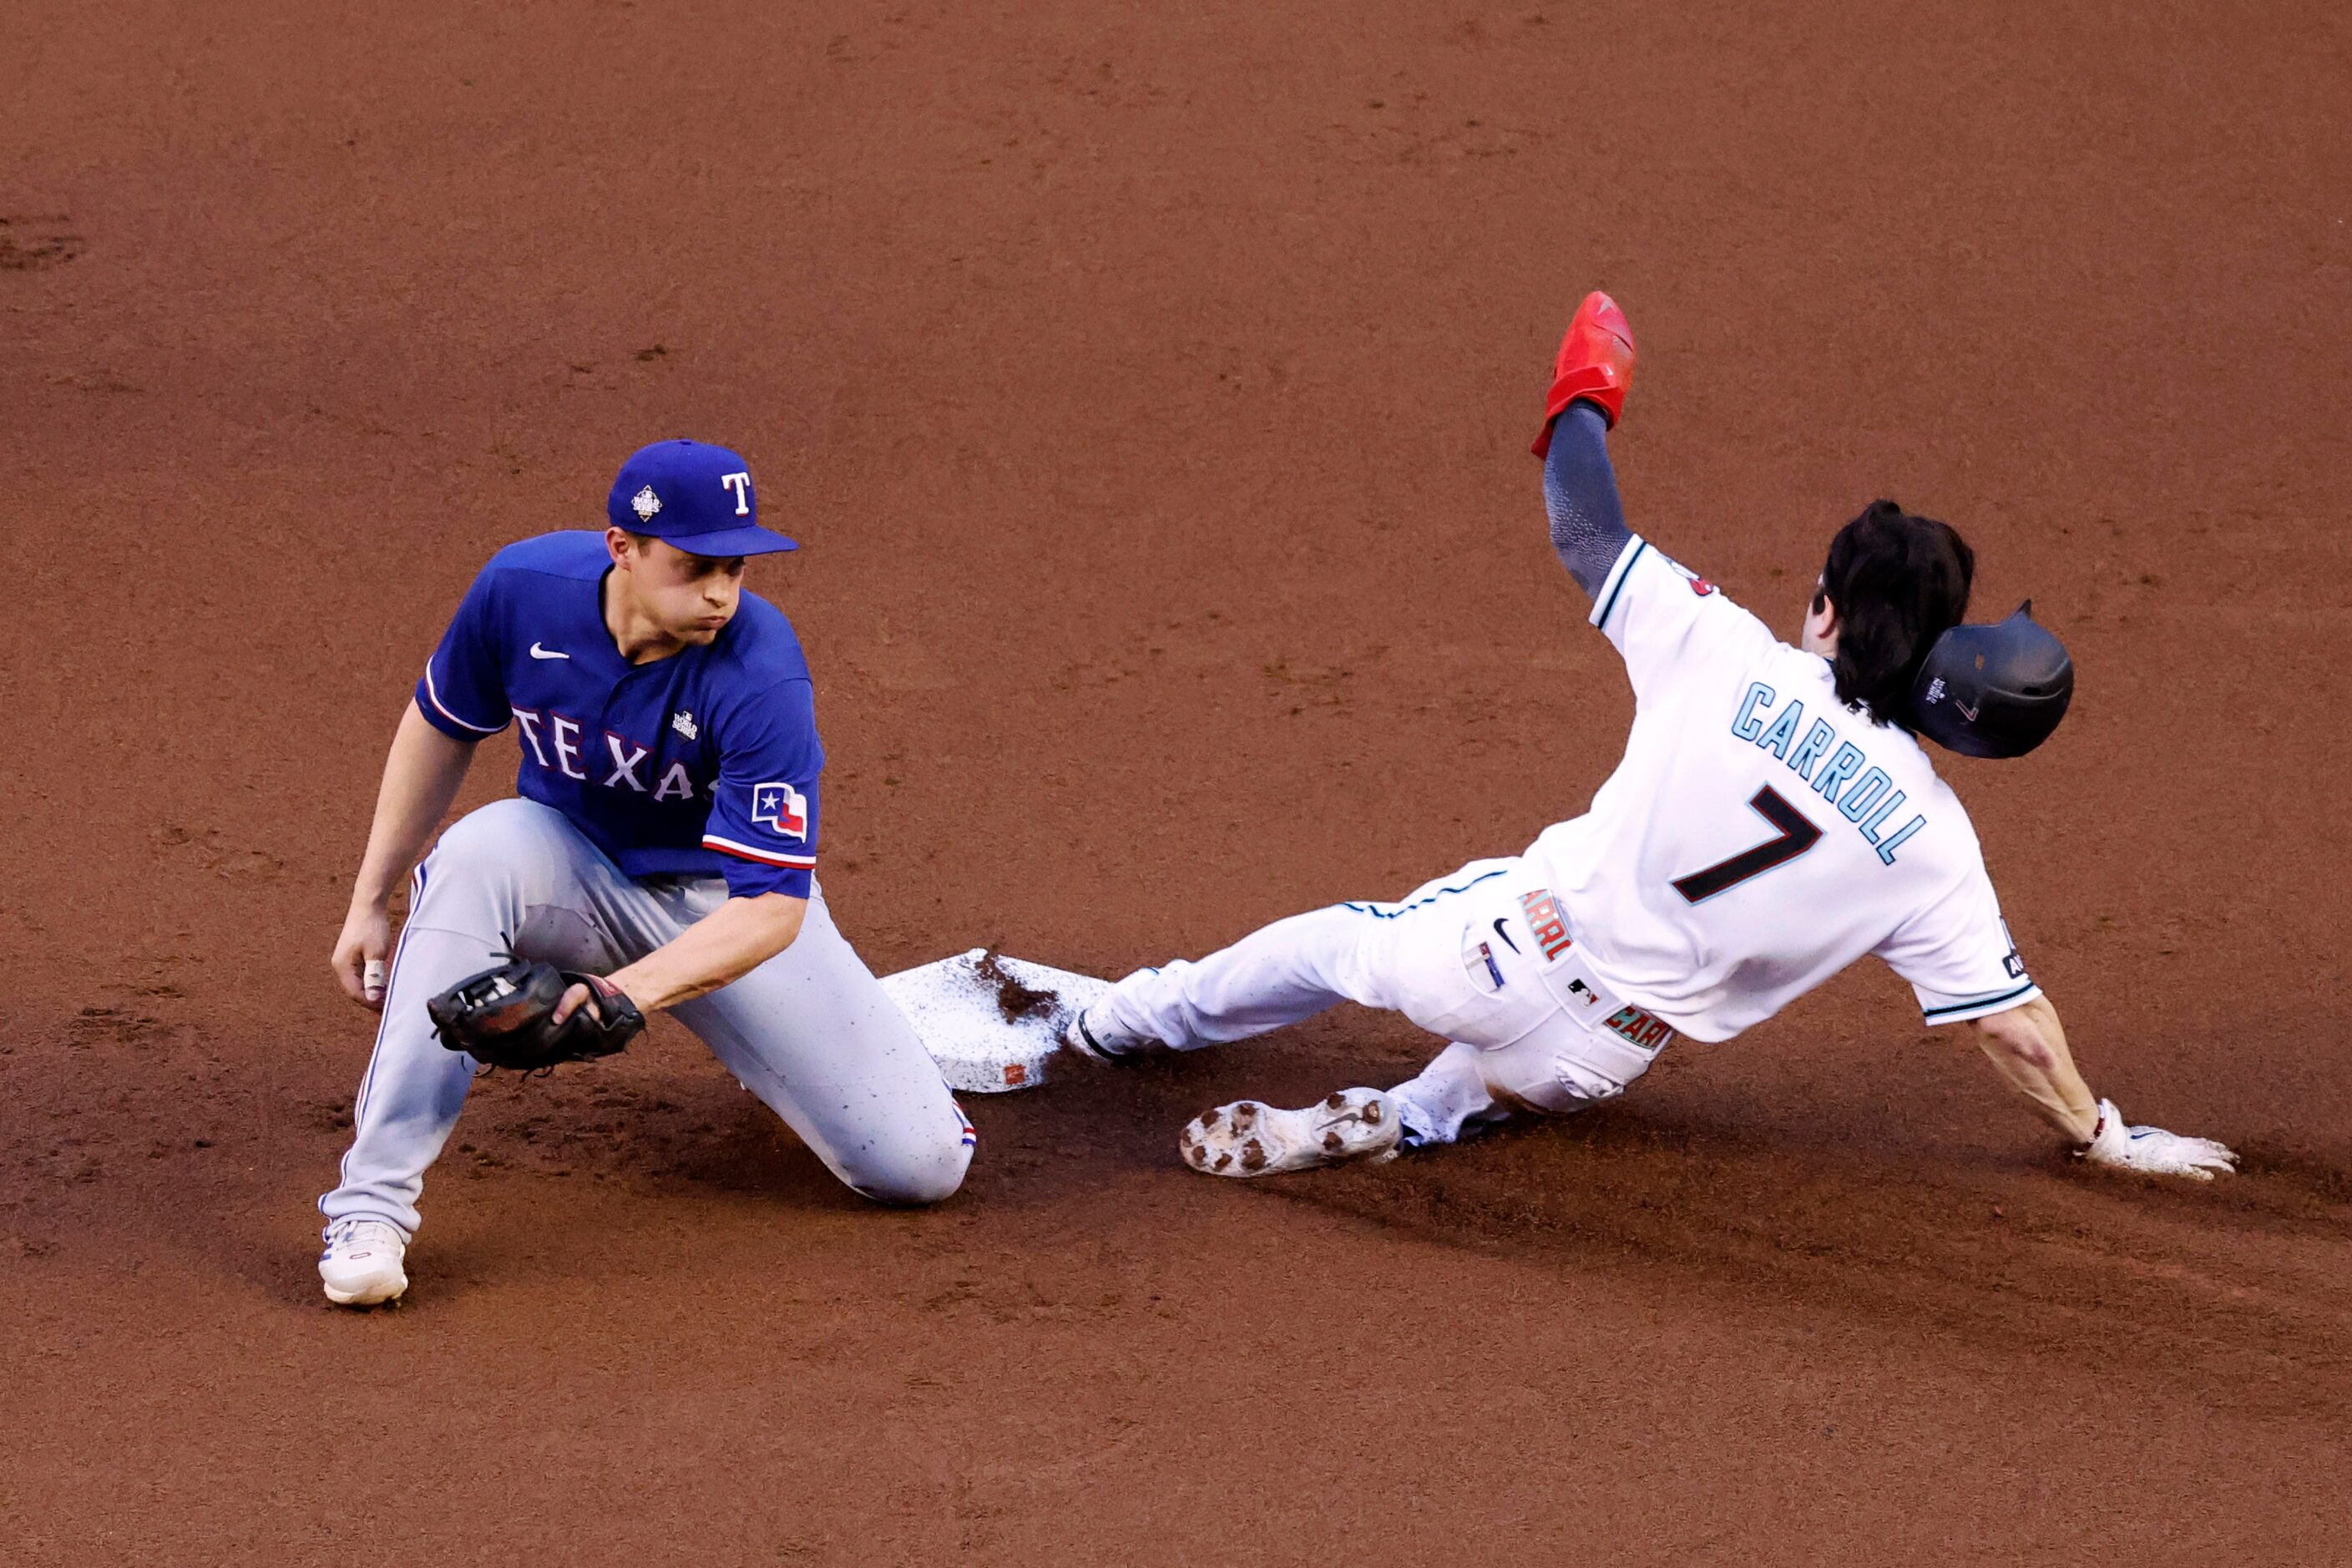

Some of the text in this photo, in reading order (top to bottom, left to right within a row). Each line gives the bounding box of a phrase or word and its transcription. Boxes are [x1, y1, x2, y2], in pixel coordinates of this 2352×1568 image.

[721, 472, 751, 517] T
[510, 705, 721, 803] TEXA
[674, 712, 698, 733] WORLD
[1732, 681, 1927, 866] CARROLL
[1668, 780, 1828, 908] 7
